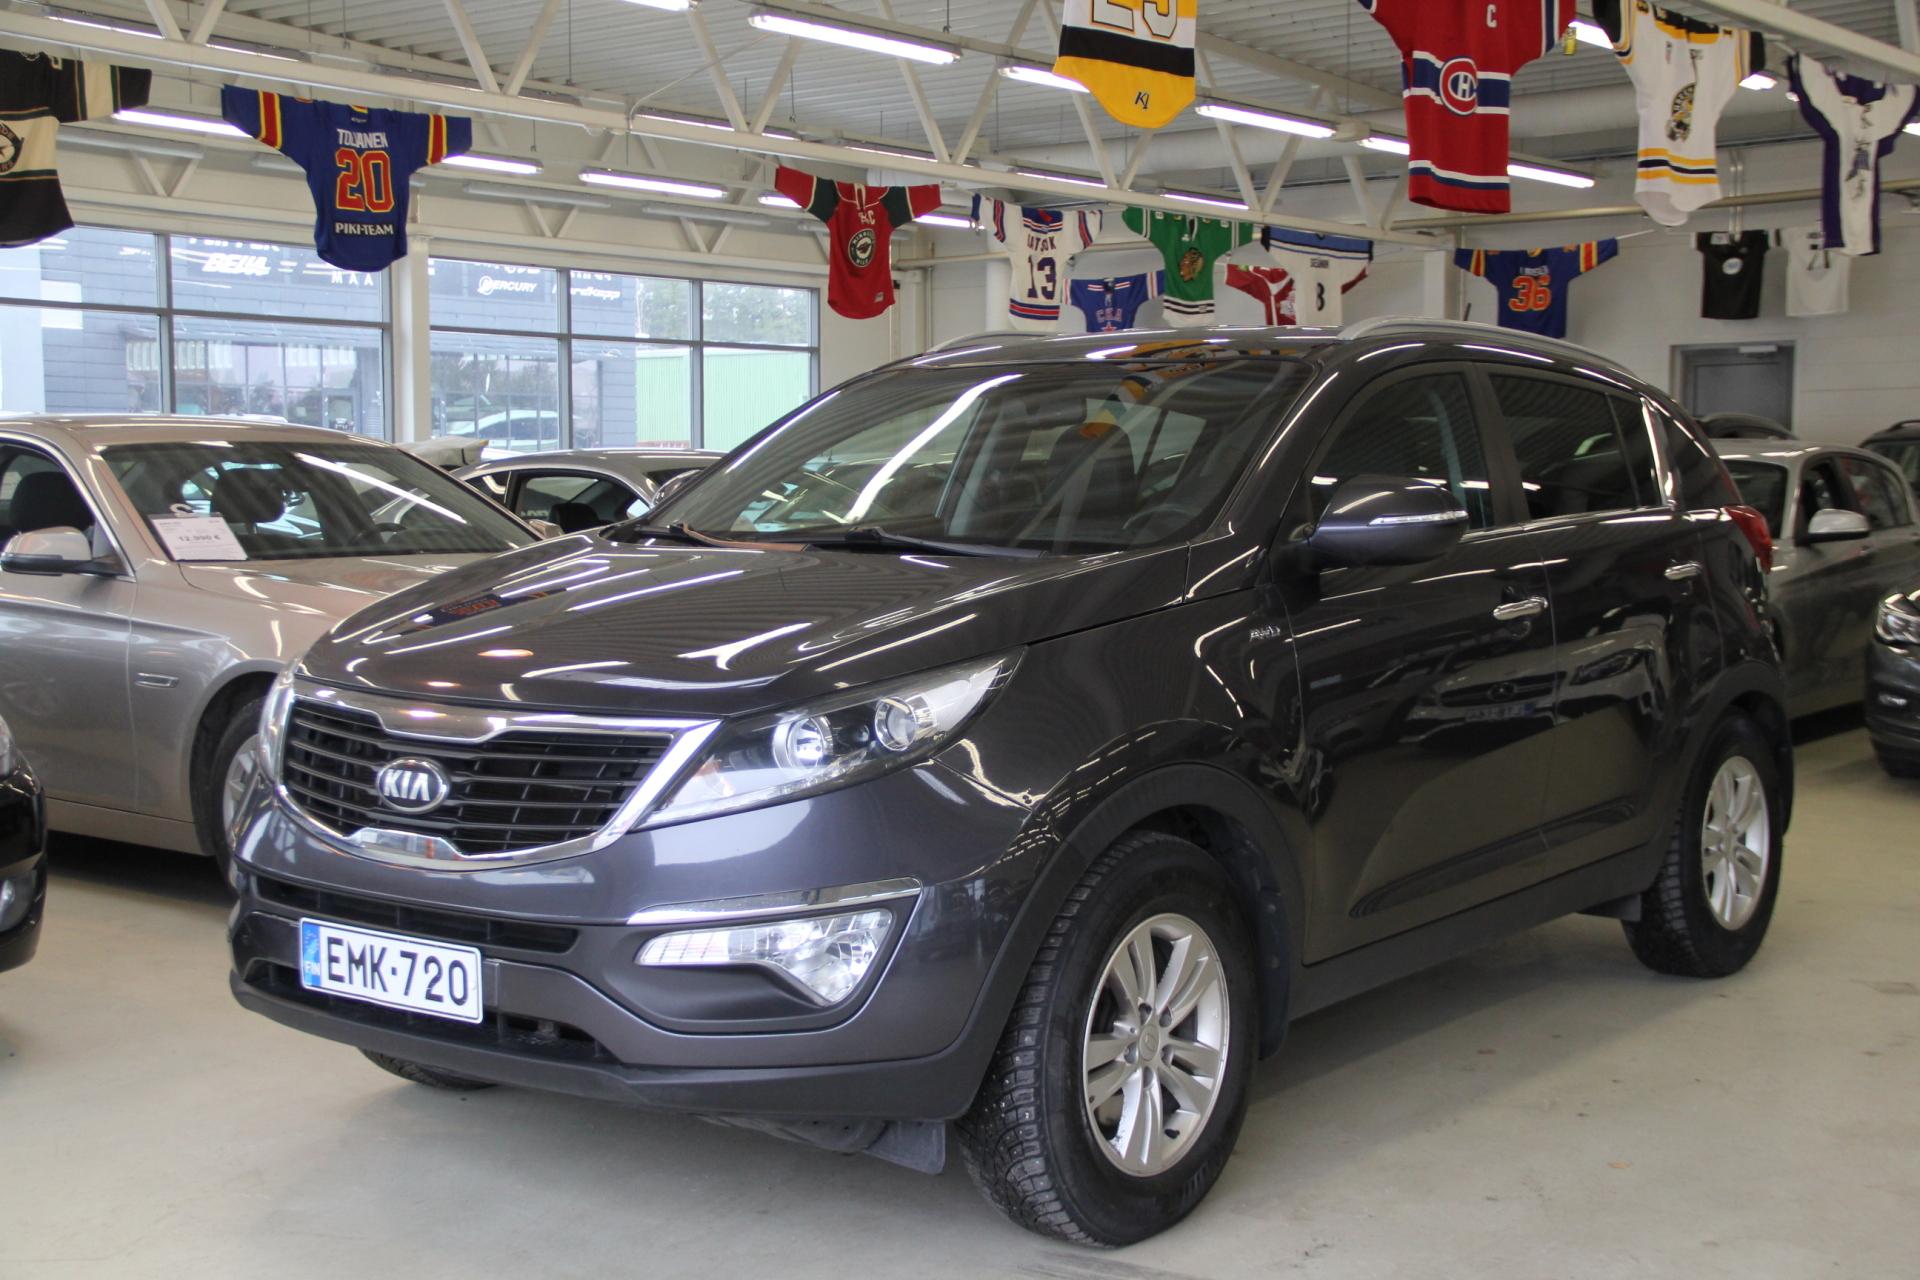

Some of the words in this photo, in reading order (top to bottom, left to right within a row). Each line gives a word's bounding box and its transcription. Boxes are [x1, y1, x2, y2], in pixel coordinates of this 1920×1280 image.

[1486, 3, 1498, 29] C
[335, 147, 394, 213] 20
[335, 222, 394, 236] PIKI-TEAM
[1027, 255, 1057, 301] 13
[1508, 275, 1551, 312] 36
[383, 768, 431, 802] KIA
[304, 962, 321, 977] FIN
[326, 935, 470, 1007] EMK-720
